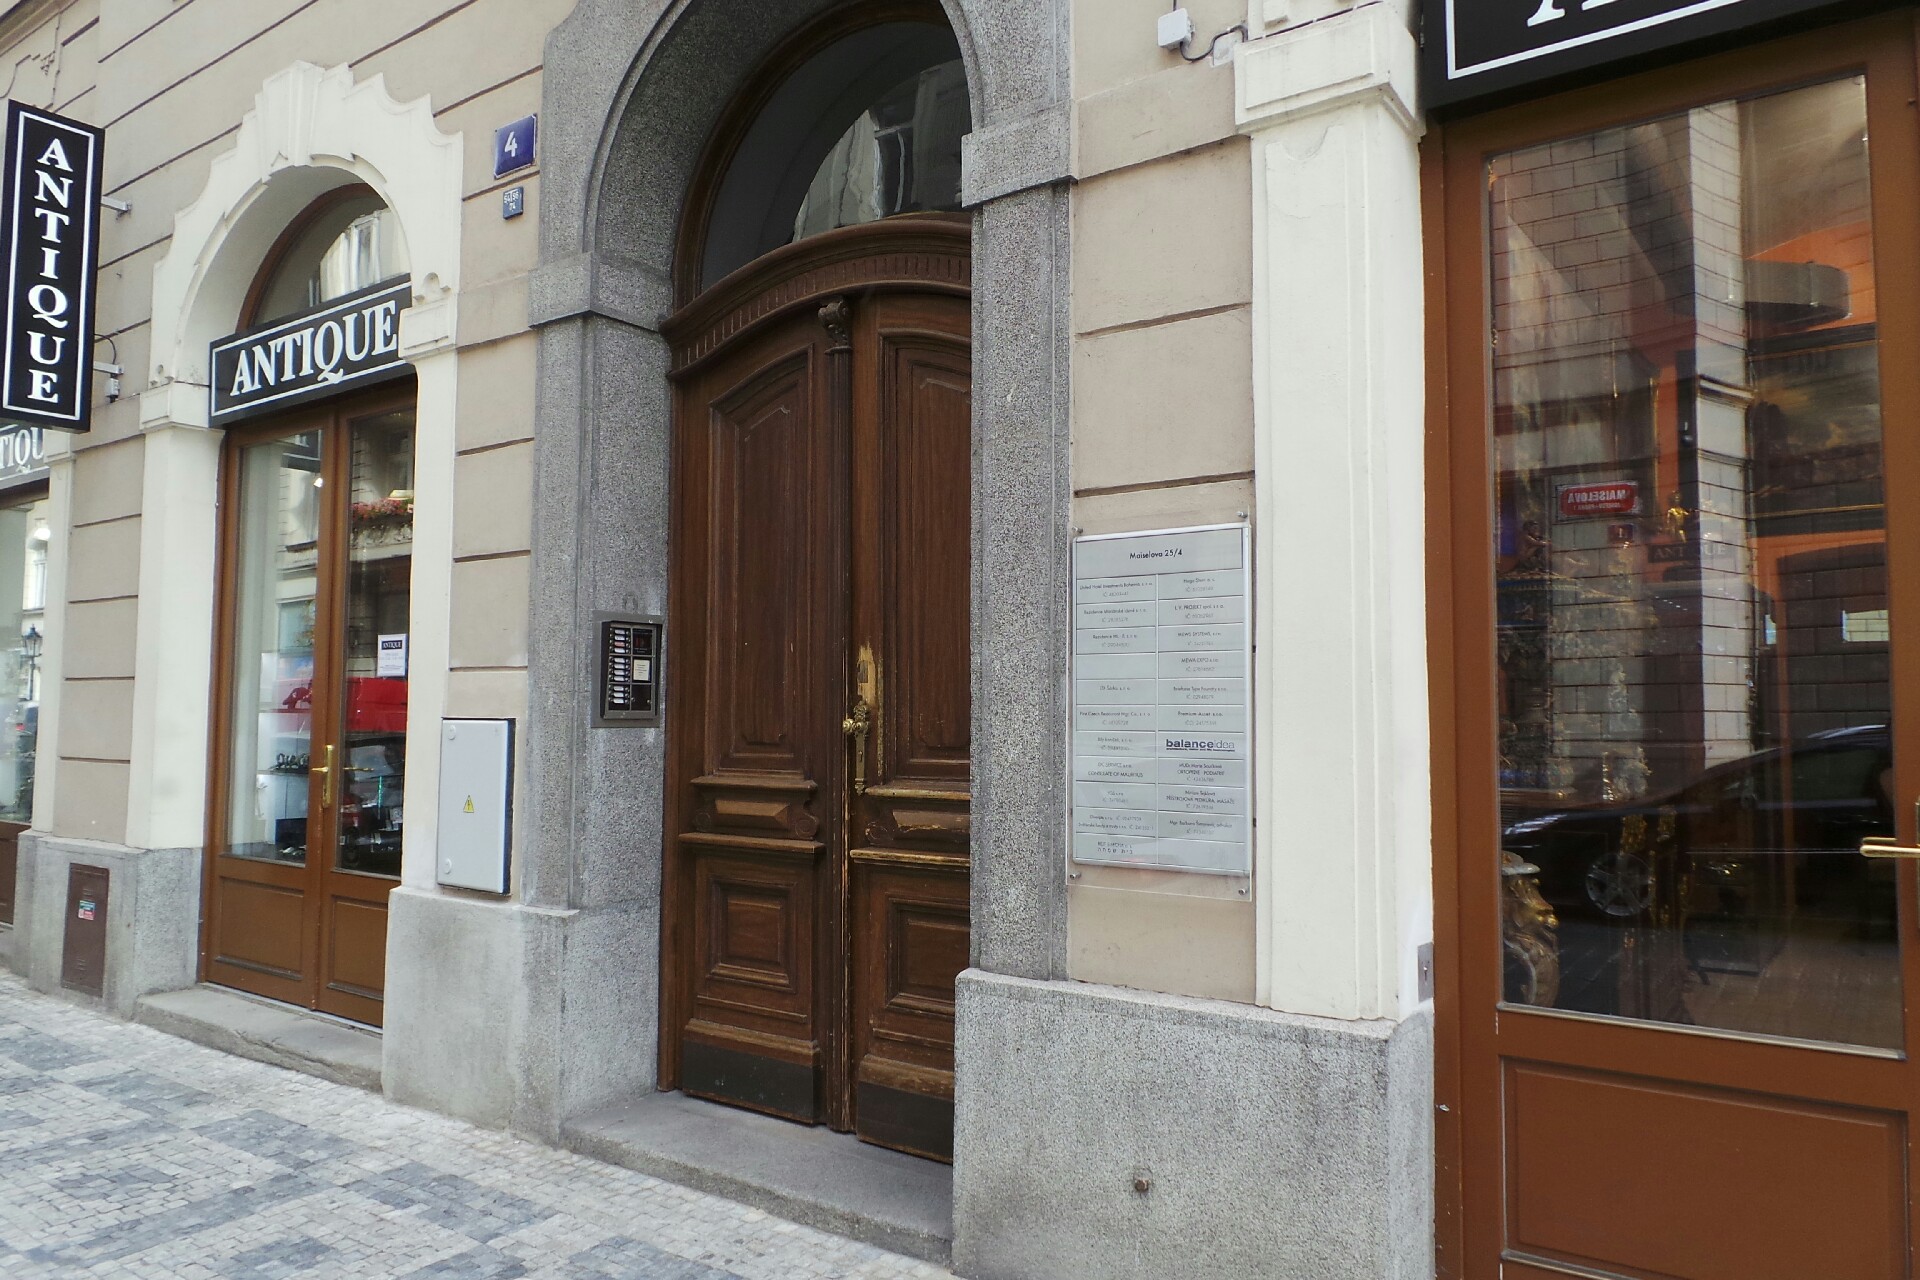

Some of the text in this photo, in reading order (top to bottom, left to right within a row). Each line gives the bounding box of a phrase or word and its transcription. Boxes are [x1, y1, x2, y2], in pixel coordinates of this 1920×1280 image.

[504, 131, 518, 158] 4
[27, 138, 73, 403] ANTIQUE
[230, 300, 397, 397] ANTIQUE
[1130, 548, 1183, 559] Maiselova 25/4
